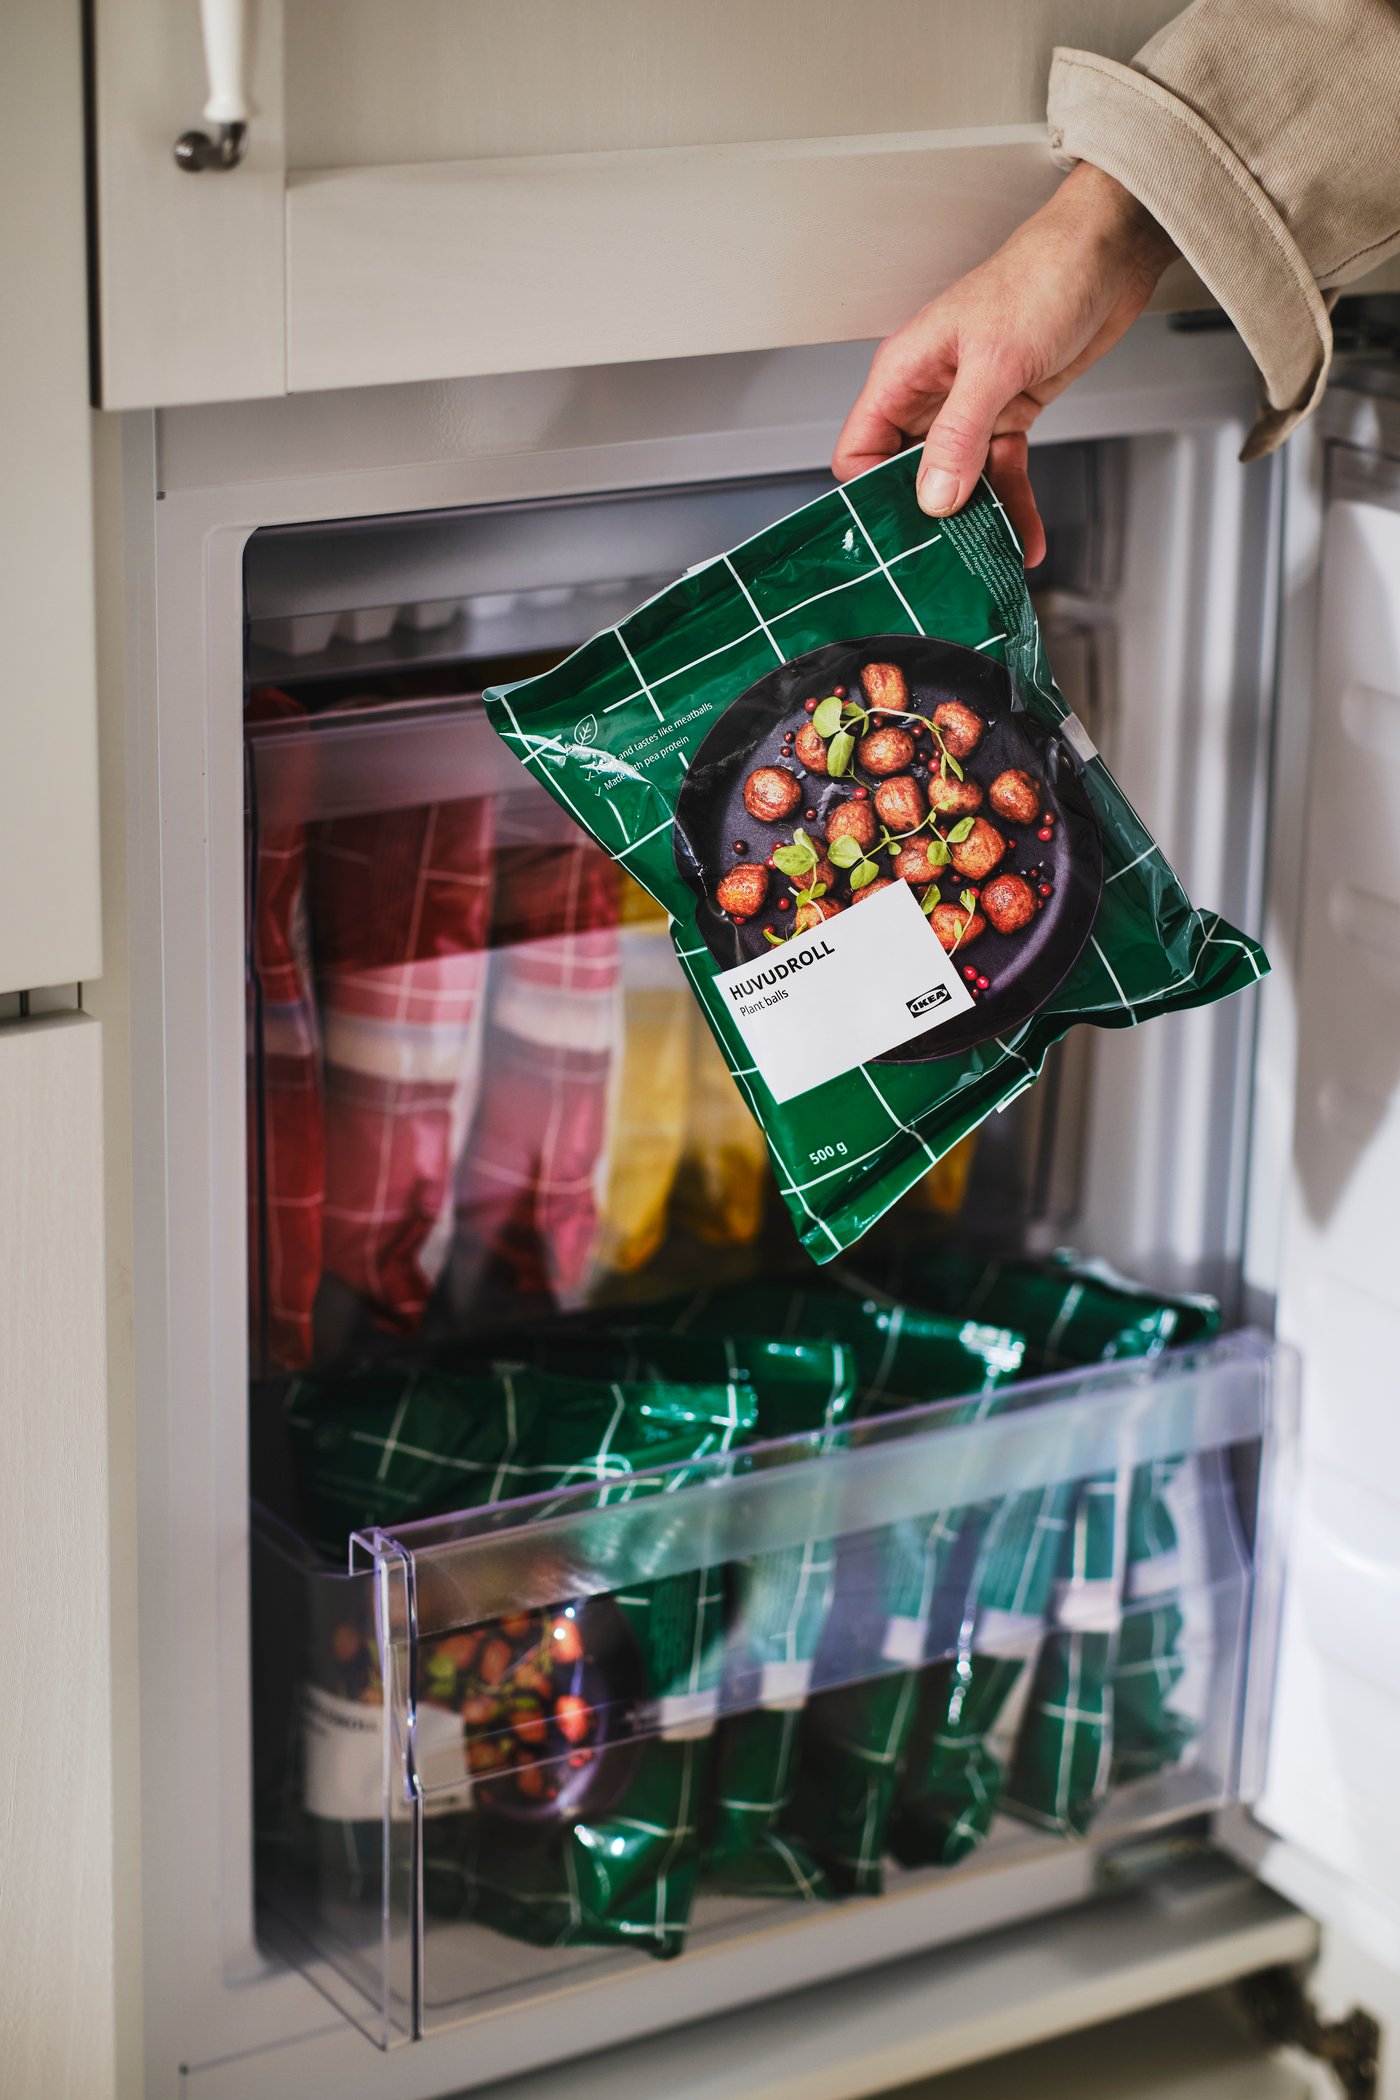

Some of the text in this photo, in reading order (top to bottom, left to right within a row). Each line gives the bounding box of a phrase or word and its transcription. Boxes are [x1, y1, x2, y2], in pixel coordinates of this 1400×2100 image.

[618, 702, 713, 761] and tastes like meatballs
[604, 773, 626, 791] Made
[644, 753, 660, 768] pea
[660, 736, 690, 758] protein
[729, 940, 836, 1001] HUVUDROLL
[739, 989, 789, 1017] Plant balls
[910, 988, 948, 1013] IKEA
[809, 1141, 848, 1165] 500 g
